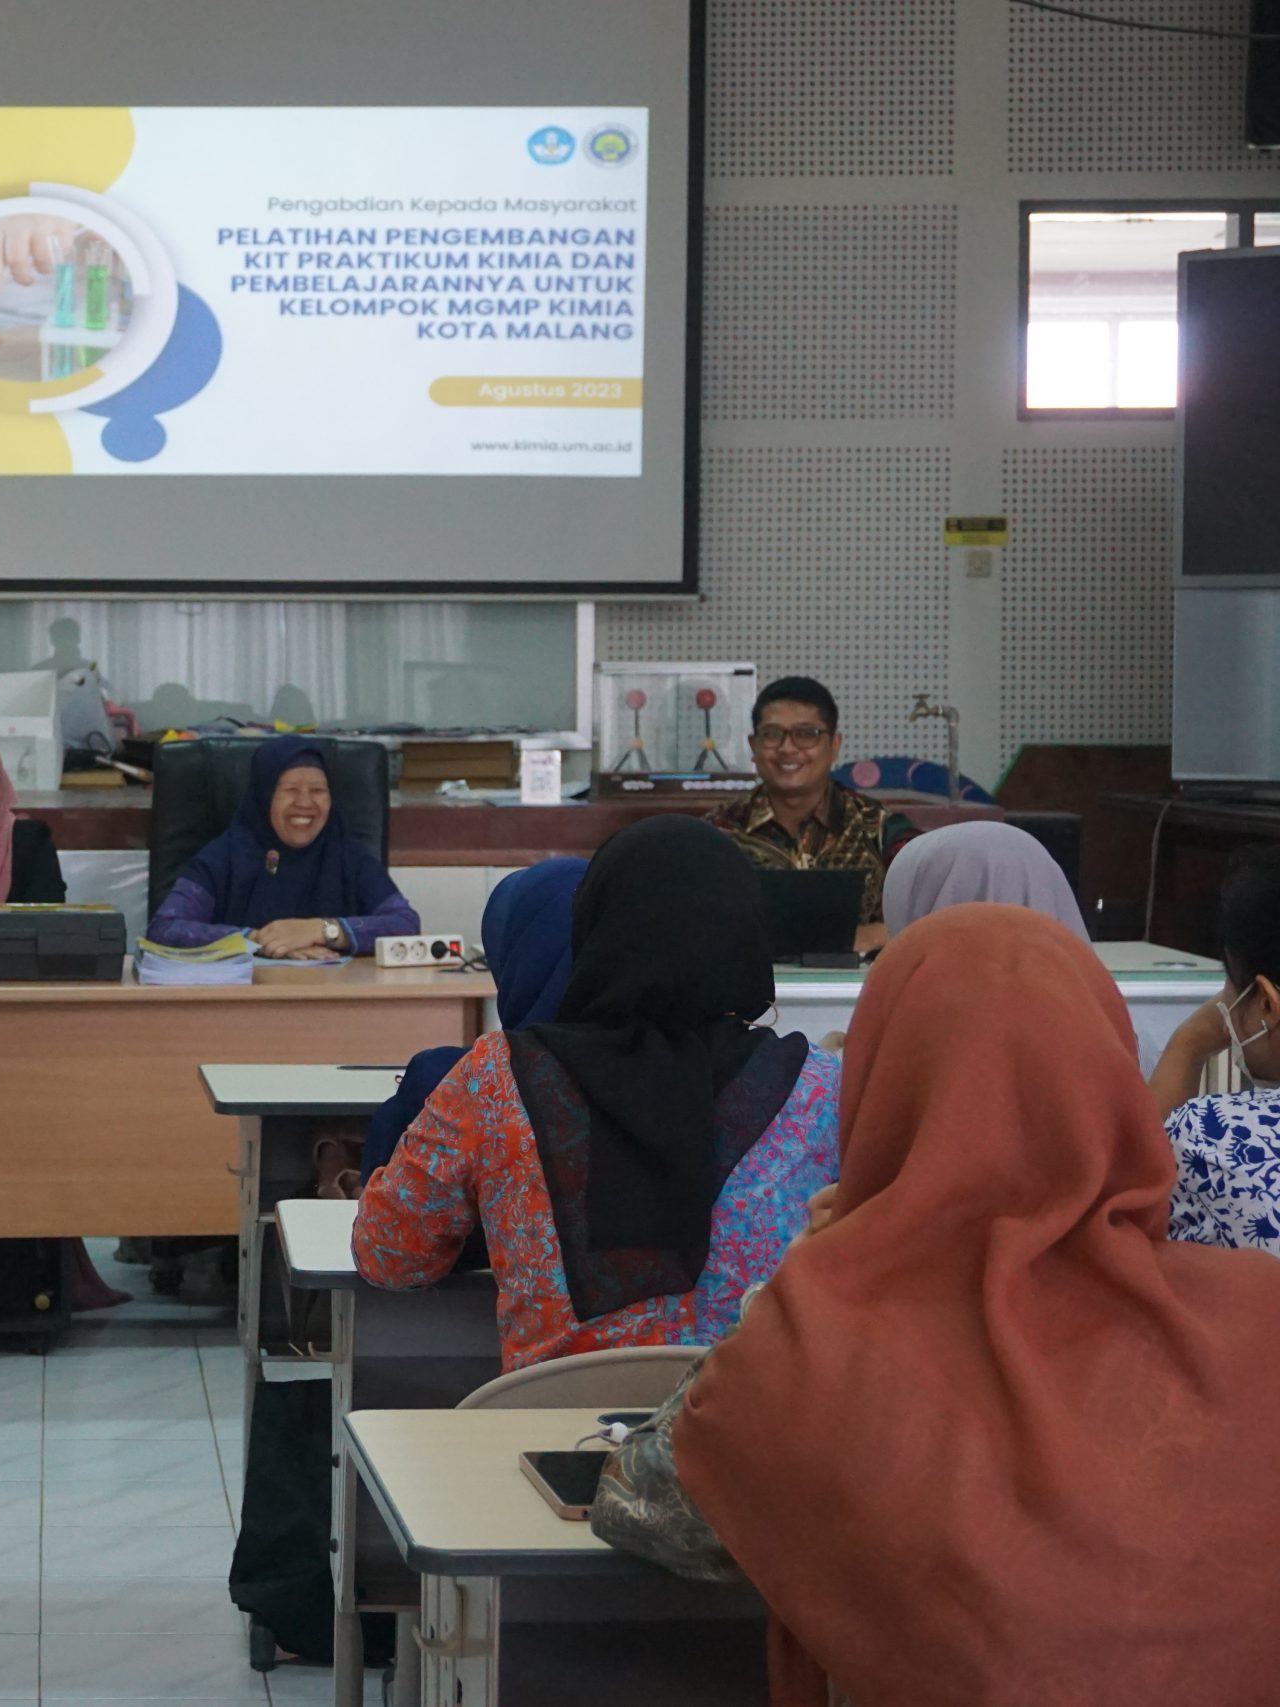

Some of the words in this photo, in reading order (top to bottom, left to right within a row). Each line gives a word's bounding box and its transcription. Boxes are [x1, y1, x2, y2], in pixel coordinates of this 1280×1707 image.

[267, 197, 404, 216] Pengabdian
[410, 197, 498, 215] Kepada
[504, 197, 637, 216] Masyarakat
[217, 228, 377, 246] PELATIHAN
[386, 228, 635, 246] PENGEMBANGAN
[244, 252, 290, 269] KIT
[298, 252, 469, 269] PRAKTIKUM
[478, 252, 563, 269] KIMIA
[572, 252, 635, 270] DAN
[230, 275, 525, 293] PEMBELAJARANNYA
[535, 275, 634, 293] UNTUK
[280, 298, 439, 316] KELOMPOK
[448, 298, 540, 317] MGMP
[549, 298, 635, 317] KIMIA
[417, 322, 498, 340] KOTA
[506, 322, 634, 341] MALANG
[479, 383, 566, 401] Agustus
[571, 383, 623, 399] 2023
[471, 440, 632, 453] www.kimia.um.ac.id
